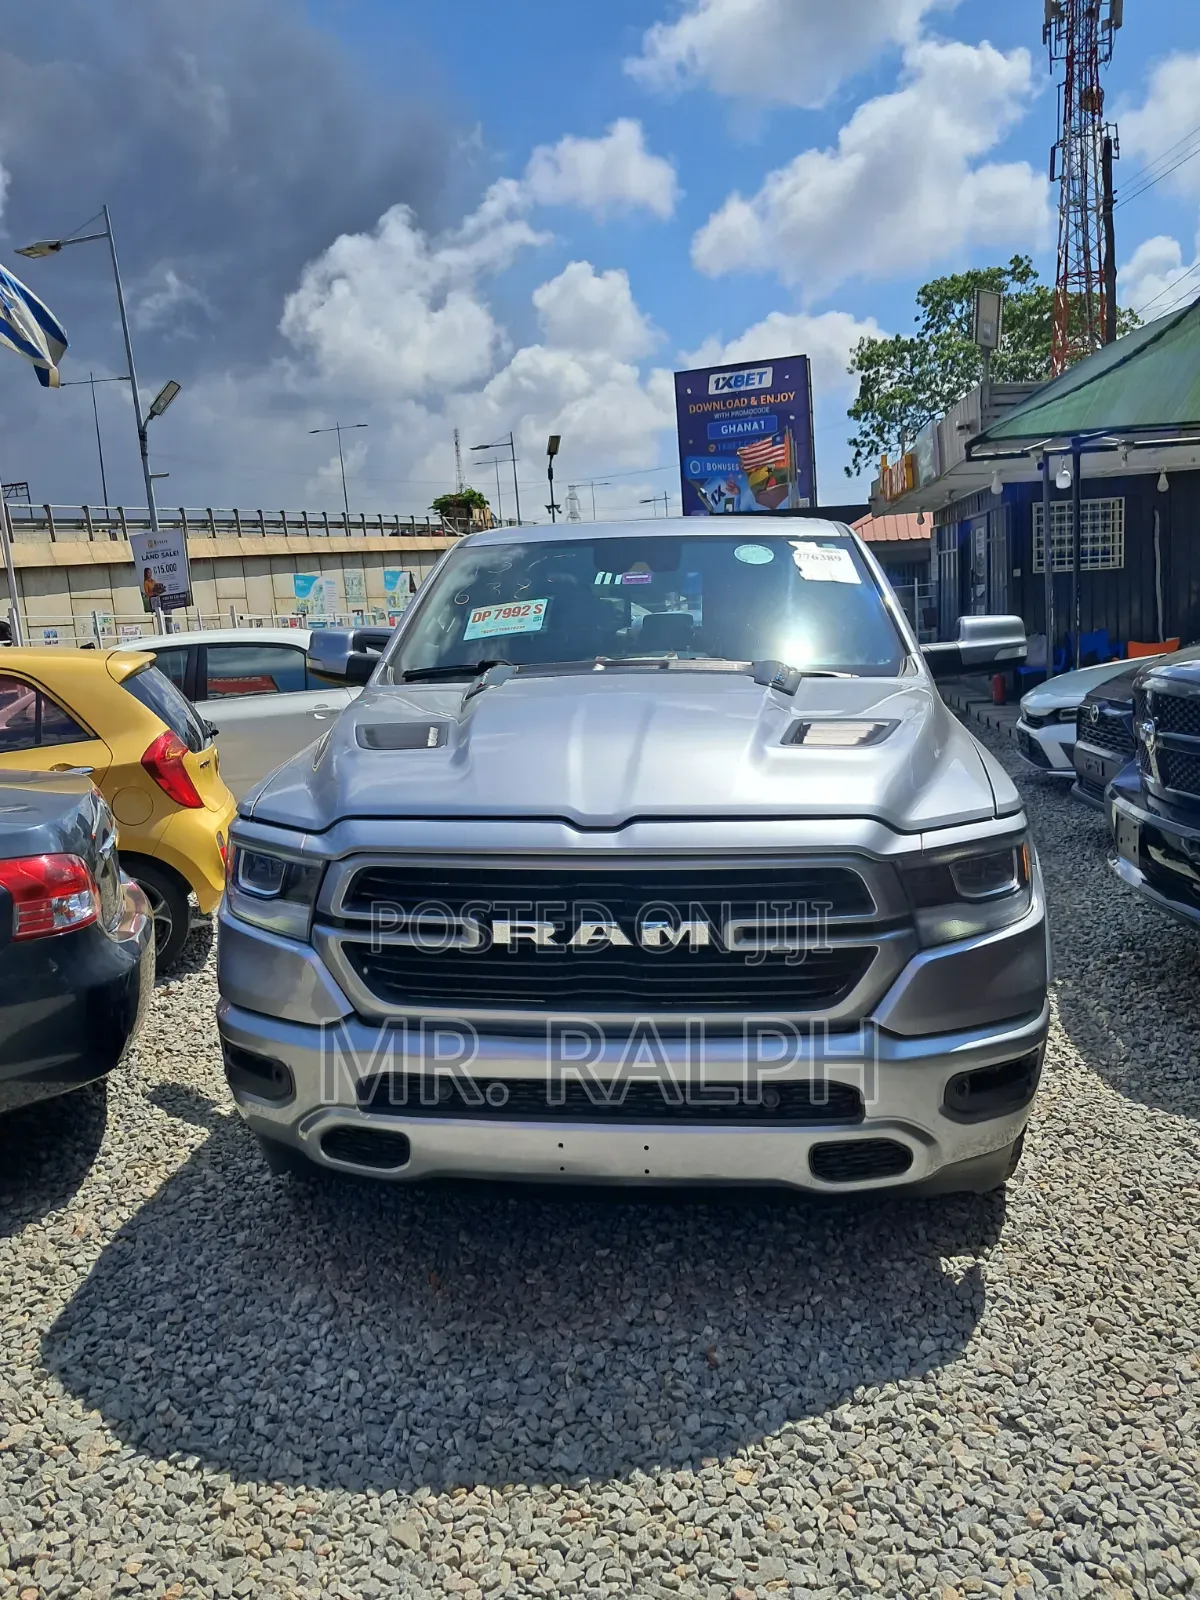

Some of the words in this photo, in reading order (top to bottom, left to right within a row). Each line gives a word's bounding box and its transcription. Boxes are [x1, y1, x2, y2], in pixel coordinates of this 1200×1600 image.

[713, 371, 768, 391] 1XBET
[688, 397, 748, 414] DOWNLOAD
[750, 396, 759, 406] &
[760, 391, 796, 405] ENJOY
[713, 411, 730, 419] WITH
[731, 406, 770, 418] PROMOCODE
[721, 420, 766, 434] GHANA1
[706, 462, 740, 471] BONUSES
[141, 553, 160, 561] LAND
[161, 550, 180, 558] SALE!
[472, 610, 492, 623] DP
[494, 605, 531, 620] 7992
[533, 603, 544, 615] S
[492, 920, 710, 946] RAM
